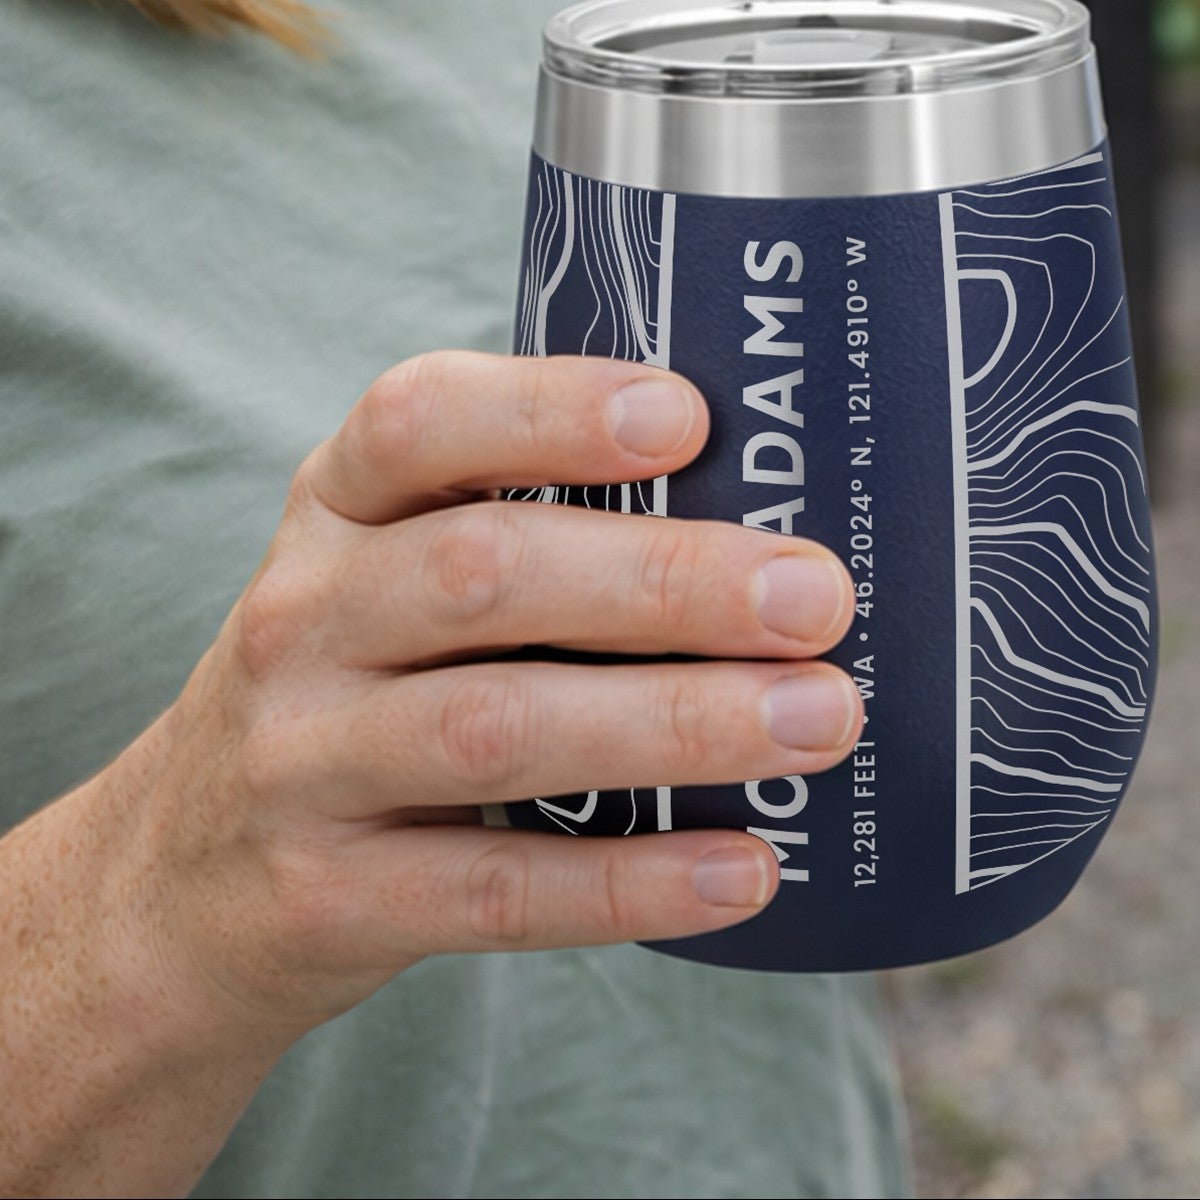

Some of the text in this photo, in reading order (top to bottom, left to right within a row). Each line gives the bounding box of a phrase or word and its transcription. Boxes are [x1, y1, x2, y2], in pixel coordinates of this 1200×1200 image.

[845, 236, 868, 267] W
[742, 240, 805, 538] ADAMS
[850, 436, 877, 466] N,
[853, 655, 876, 701] WA
[853, 740, 876, 798] FEET
[853, 810, 879, 888] 12,281
